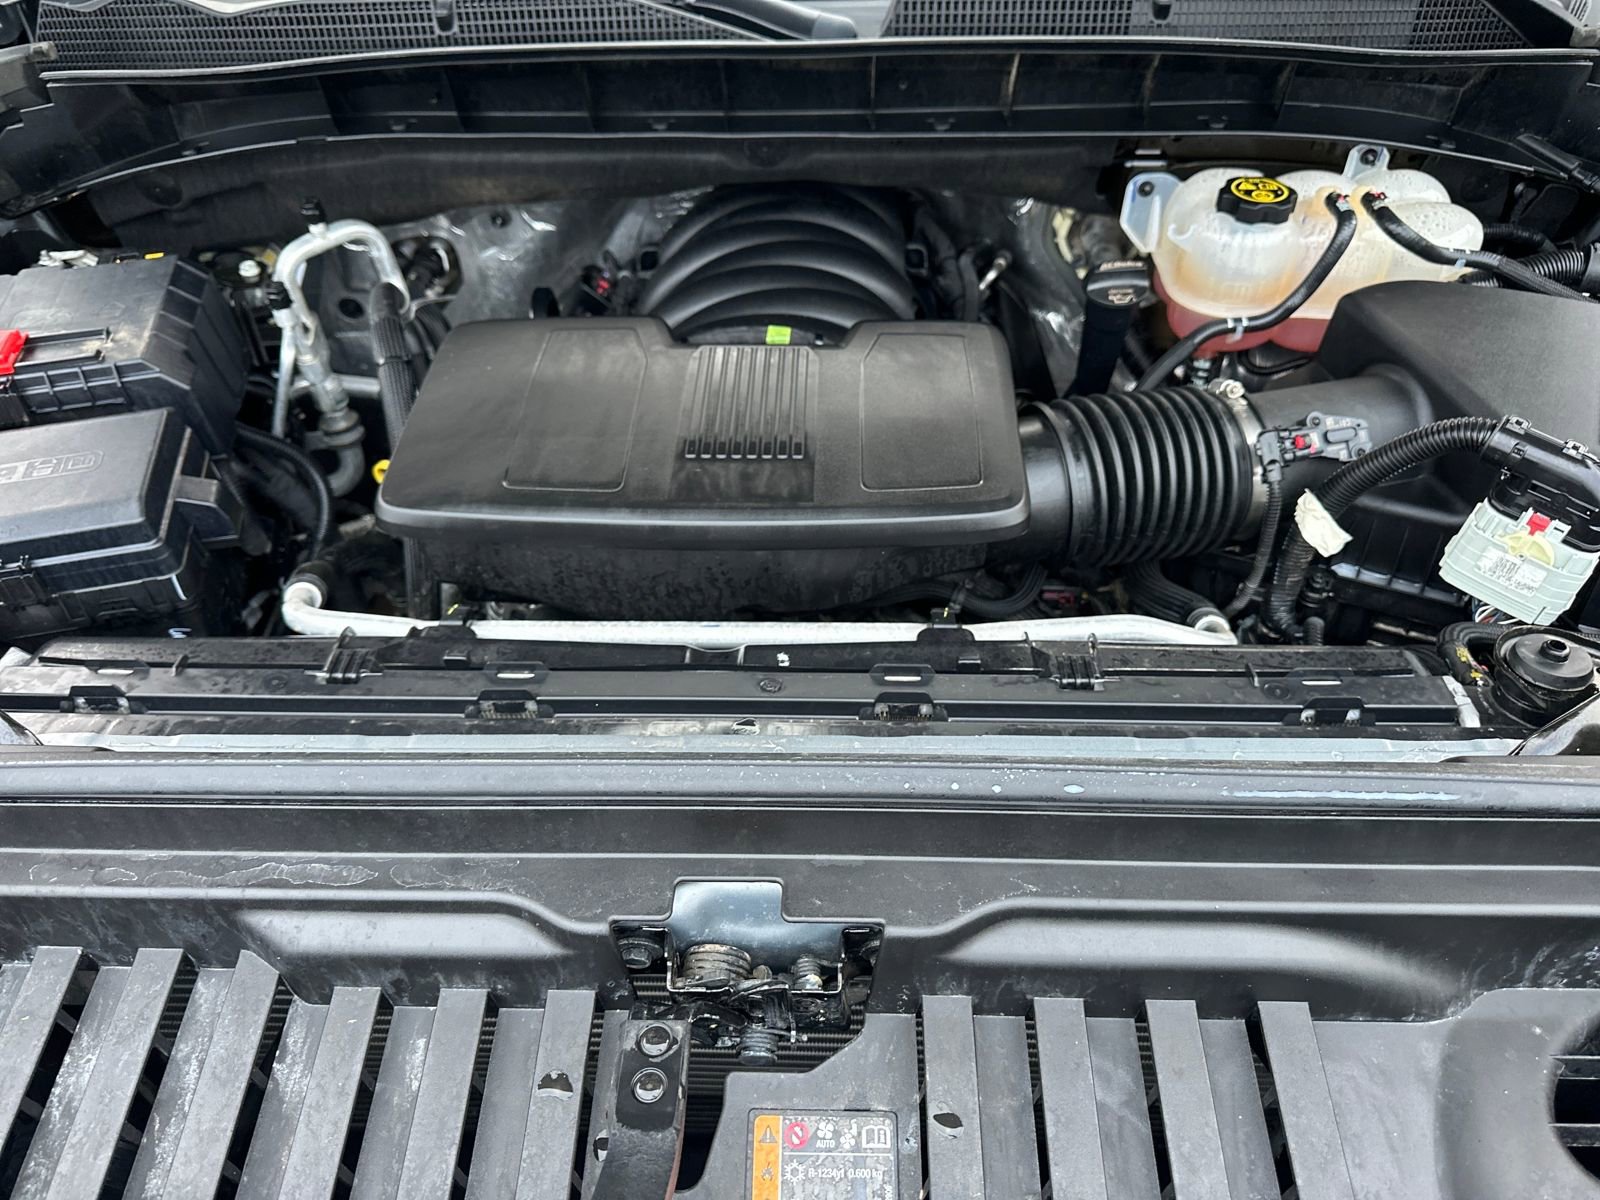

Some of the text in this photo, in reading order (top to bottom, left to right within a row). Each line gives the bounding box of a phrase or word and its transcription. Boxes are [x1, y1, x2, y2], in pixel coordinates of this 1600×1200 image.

[816, 1139, 836, 1149] AUTO
[848, 1168, 871, 1178] 0.600
[872, 1168, 883, 1181] kg
